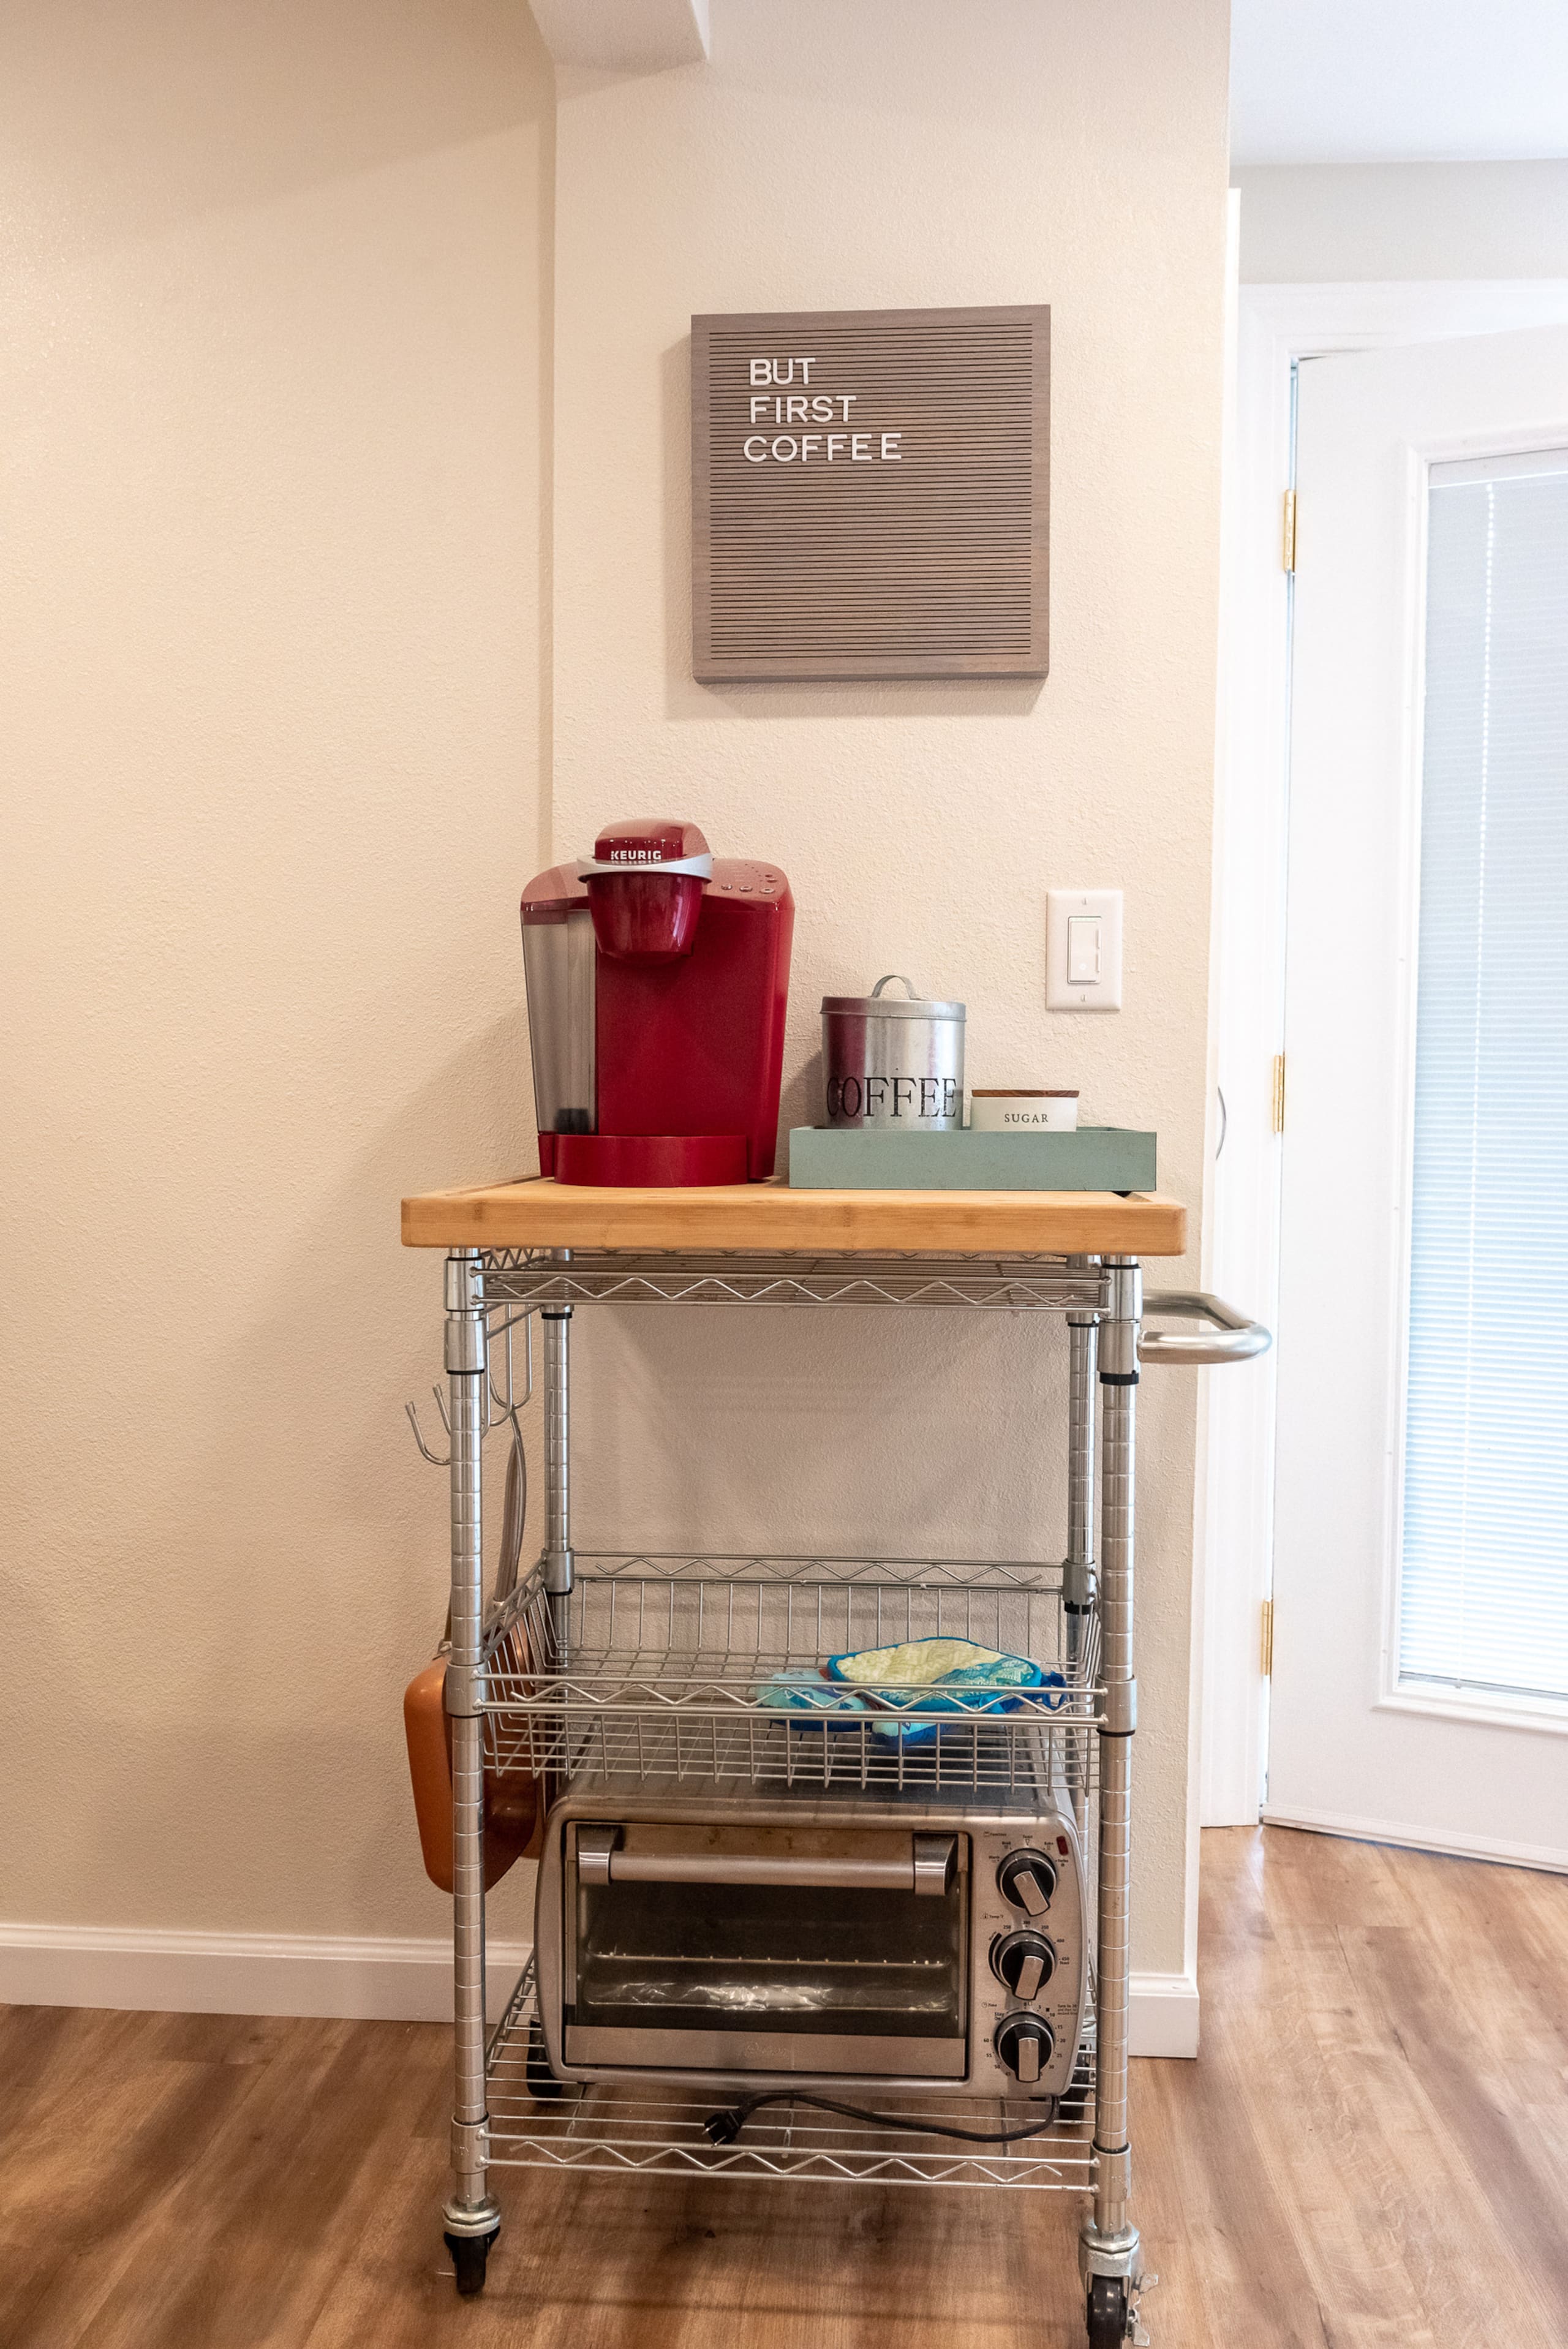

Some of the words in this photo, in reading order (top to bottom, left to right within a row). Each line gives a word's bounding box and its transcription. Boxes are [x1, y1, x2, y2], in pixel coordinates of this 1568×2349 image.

[750, 358, 816, 386] BUT
[750, 396, 856, 424] FIRST
[744, 433, 902, 462] COFFEE
[611, 850, 662, 860] KEURIG
[827, 1076, 957, 1117] COFFEE
[1004, 1113, 1049, 1123] SUGAR
